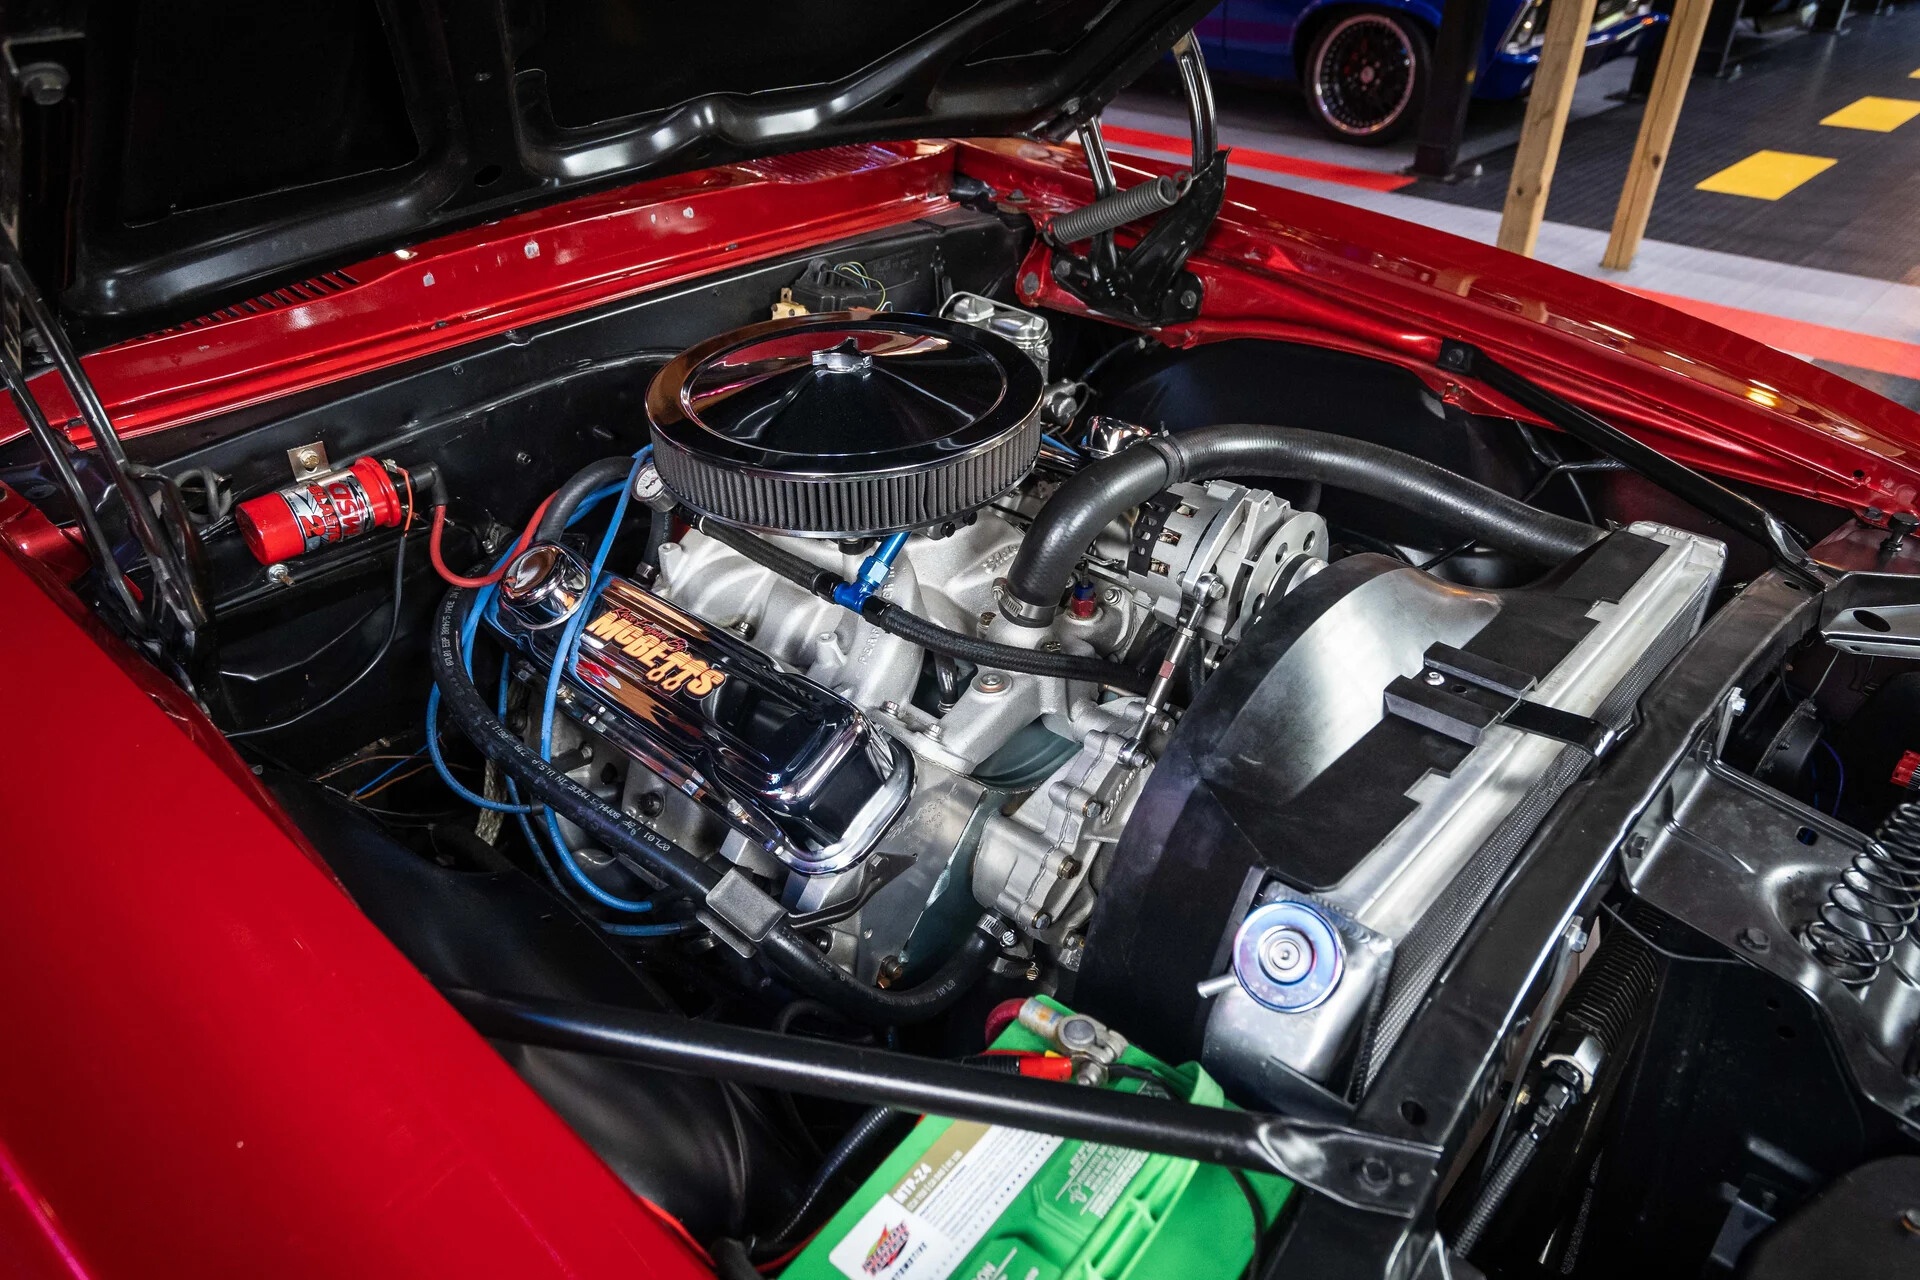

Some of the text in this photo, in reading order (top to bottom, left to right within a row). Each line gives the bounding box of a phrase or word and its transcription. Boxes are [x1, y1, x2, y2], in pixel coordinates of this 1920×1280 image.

[302, 515, 327, 537] 2
[329, 483, 363, 536] MSD
[614, 605, 635, 622] Race
[634, 617, 668, 639] Engines
[568, 783, 590, 799] MADE
[892, 1164, 933, 1204] MTP-24
